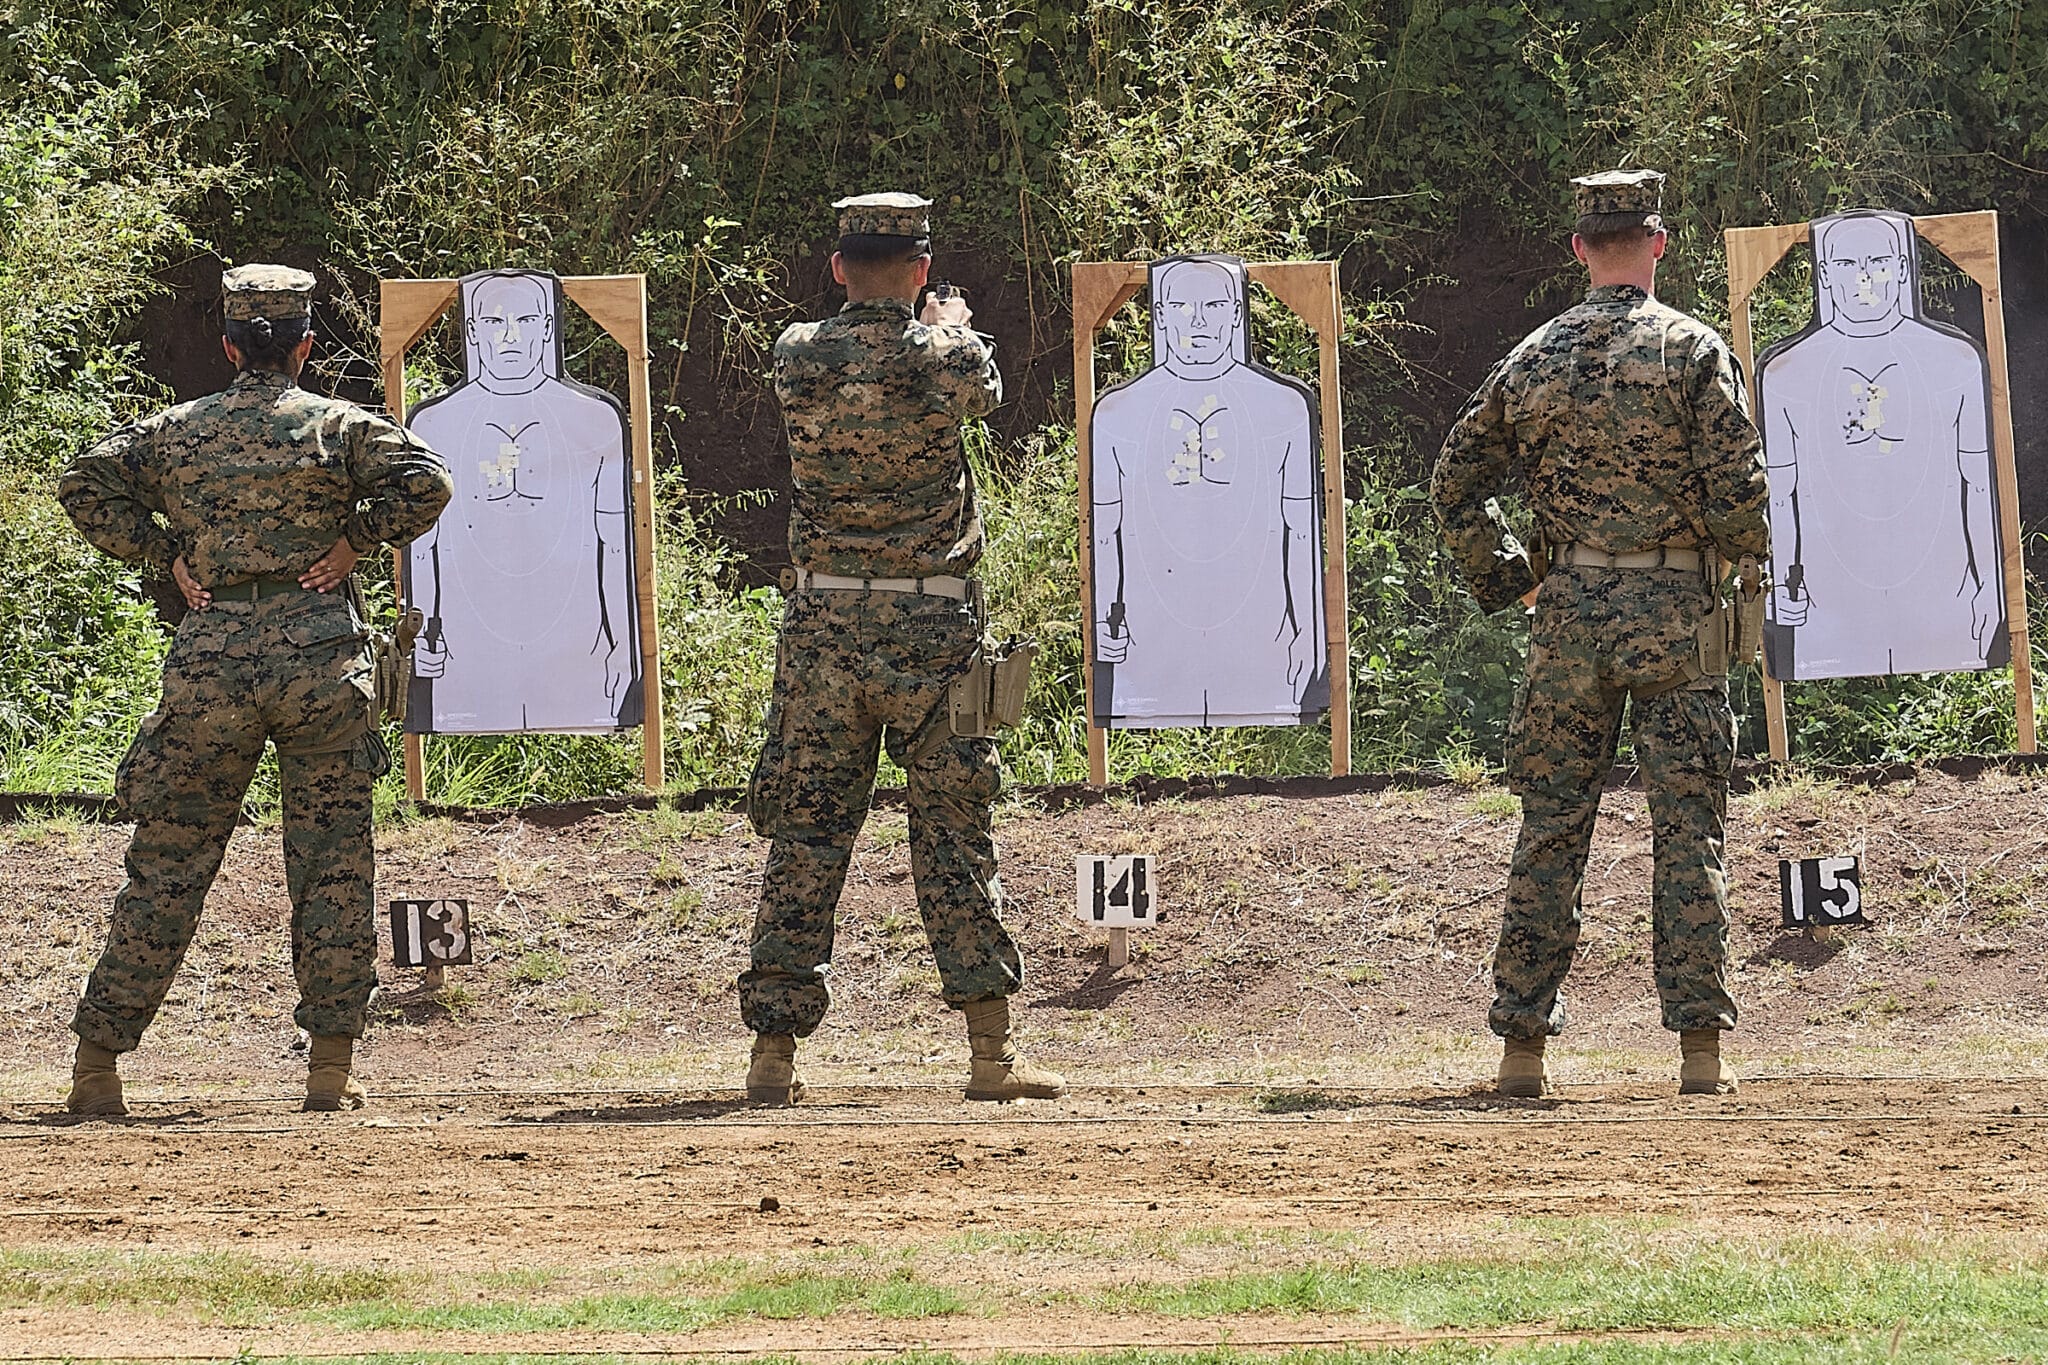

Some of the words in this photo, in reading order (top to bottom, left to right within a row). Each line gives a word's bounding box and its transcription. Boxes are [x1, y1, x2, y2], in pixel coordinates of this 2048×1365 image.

[1092, 858, 1149, 921] 14
[1790, 857, 1859, 920] 15
[406, 900, 466, 965] 13
